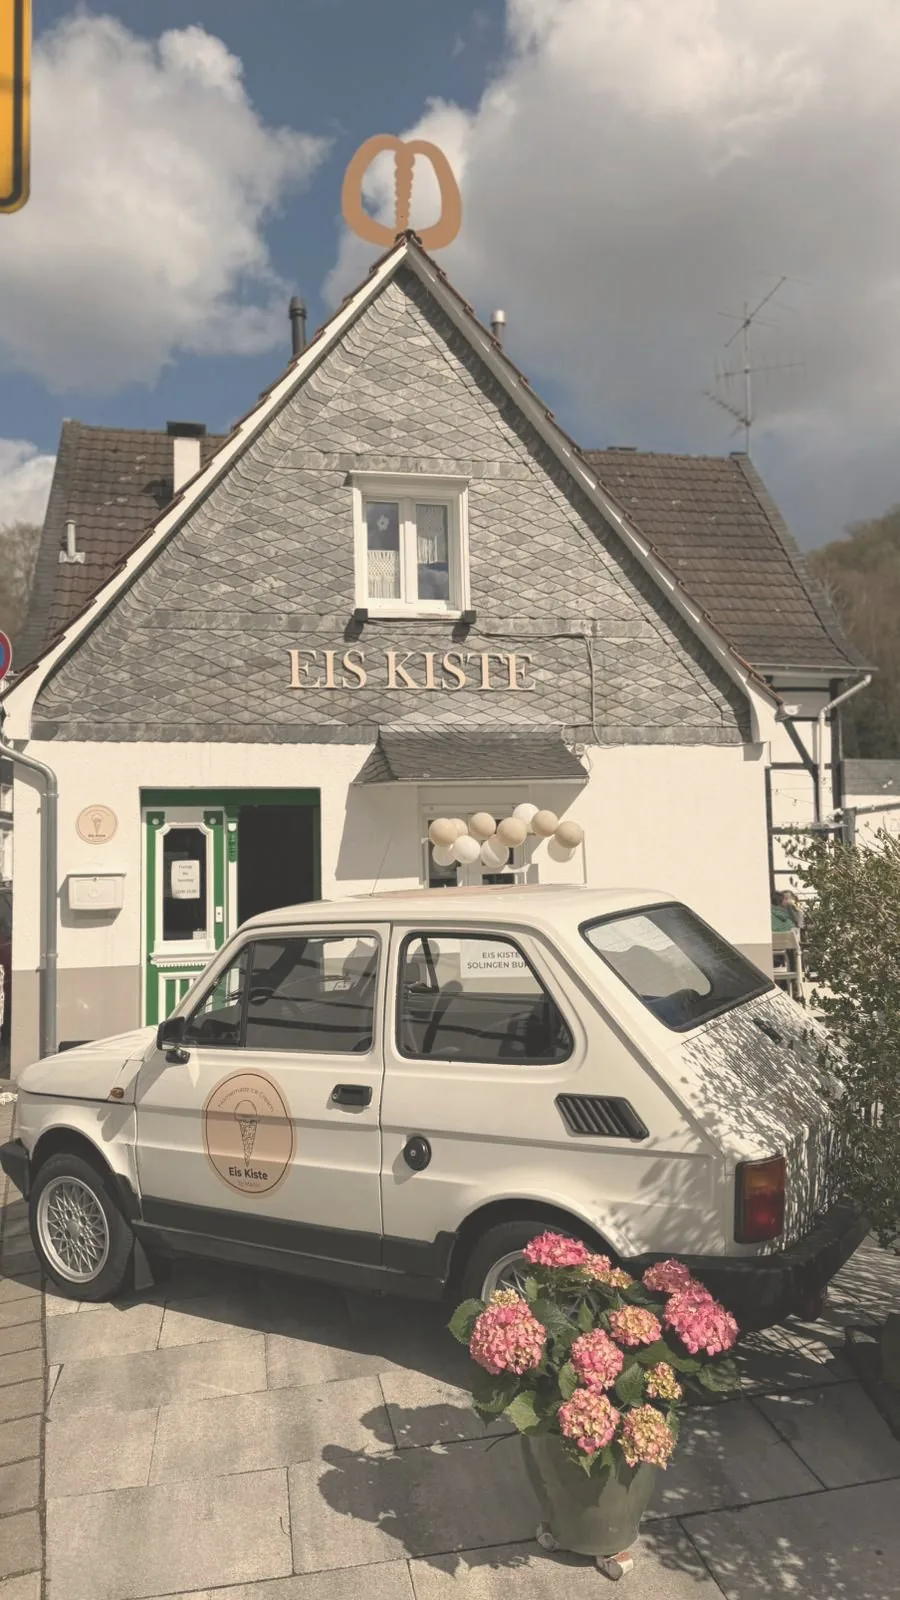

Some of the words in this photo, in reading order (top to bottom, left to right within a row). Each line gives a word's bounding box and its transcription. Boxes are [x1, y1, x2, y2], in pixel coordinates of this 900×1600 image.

[285, 648, 368, 690] EIS
[384, 650, 537, 692] KISTE
[482, 951, 495, 959] EIS
[467, 961, 510, 969] SOLINGEN
[228, 1166, 243, 1177] Eis
[244, 1168, 269, 1181] Kiste
